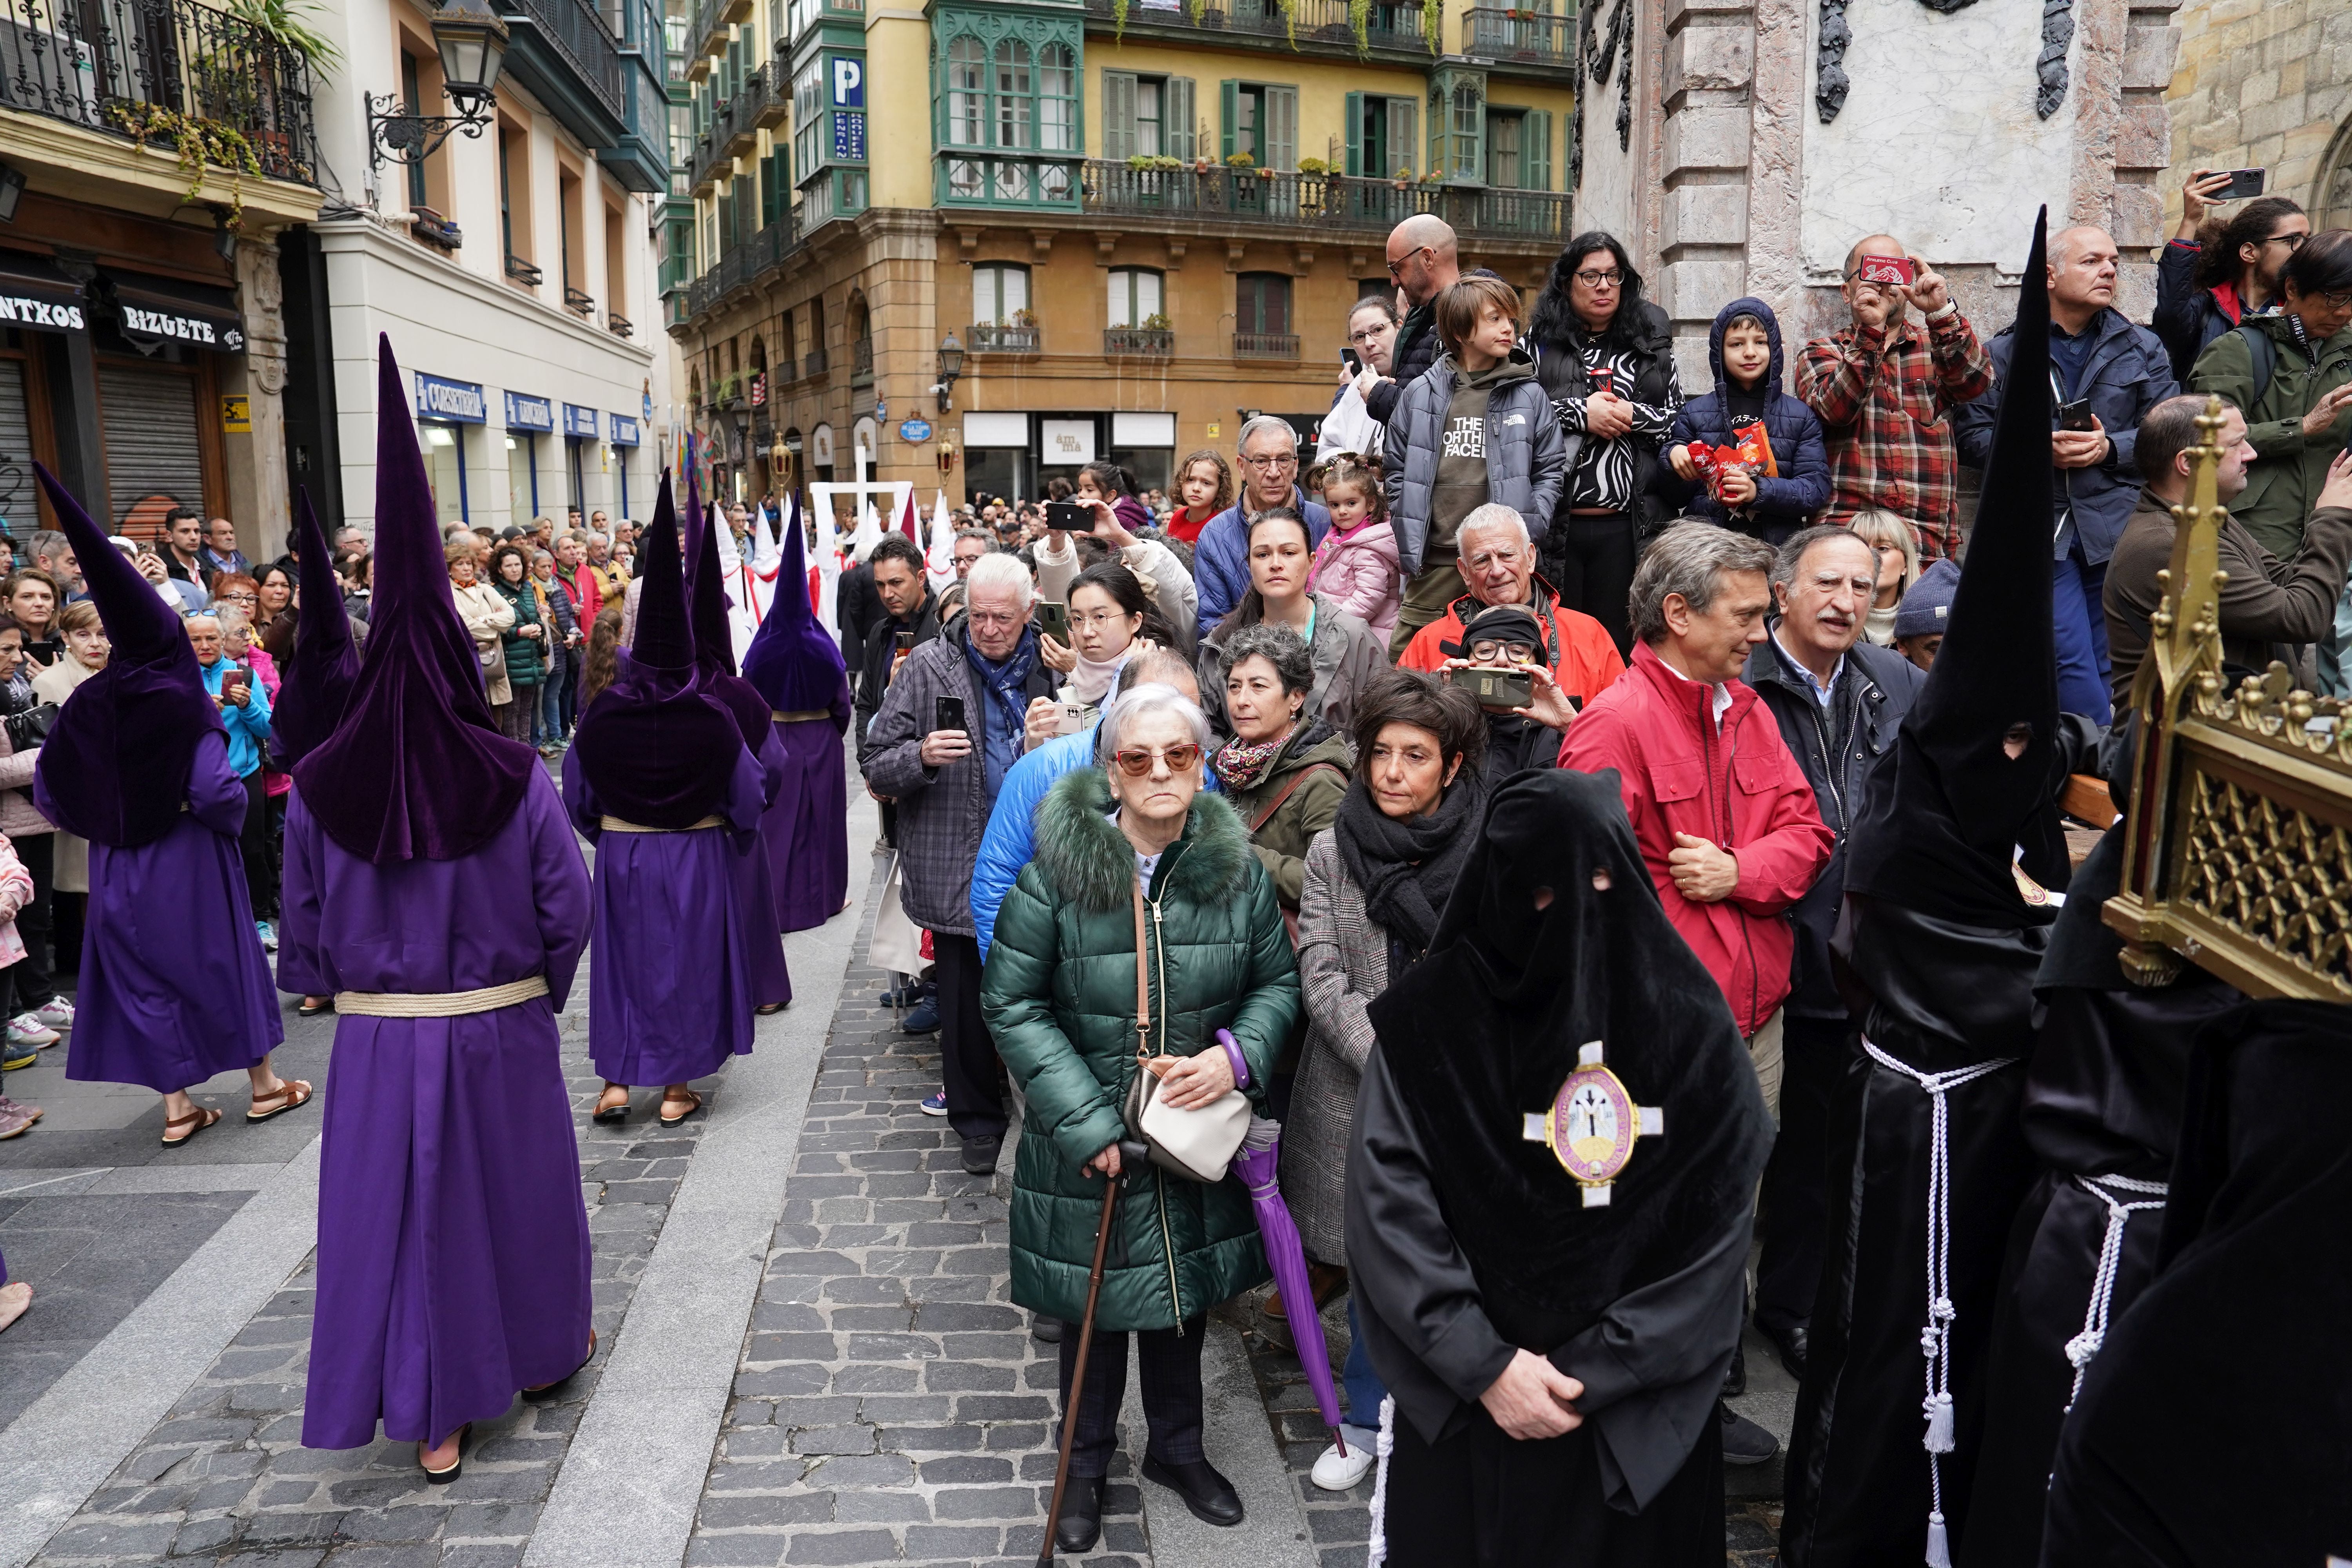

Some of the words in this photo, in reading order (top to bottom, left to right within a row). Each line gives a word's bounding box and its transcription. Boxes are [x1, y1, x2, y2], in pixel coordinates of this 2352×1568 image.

[834, 60, 860, 104] P
[1454, 417, 1483, 431] THE
[1442, 430, 1482, 445] ORTH
[1445, 443, 1481, 458] FACE
